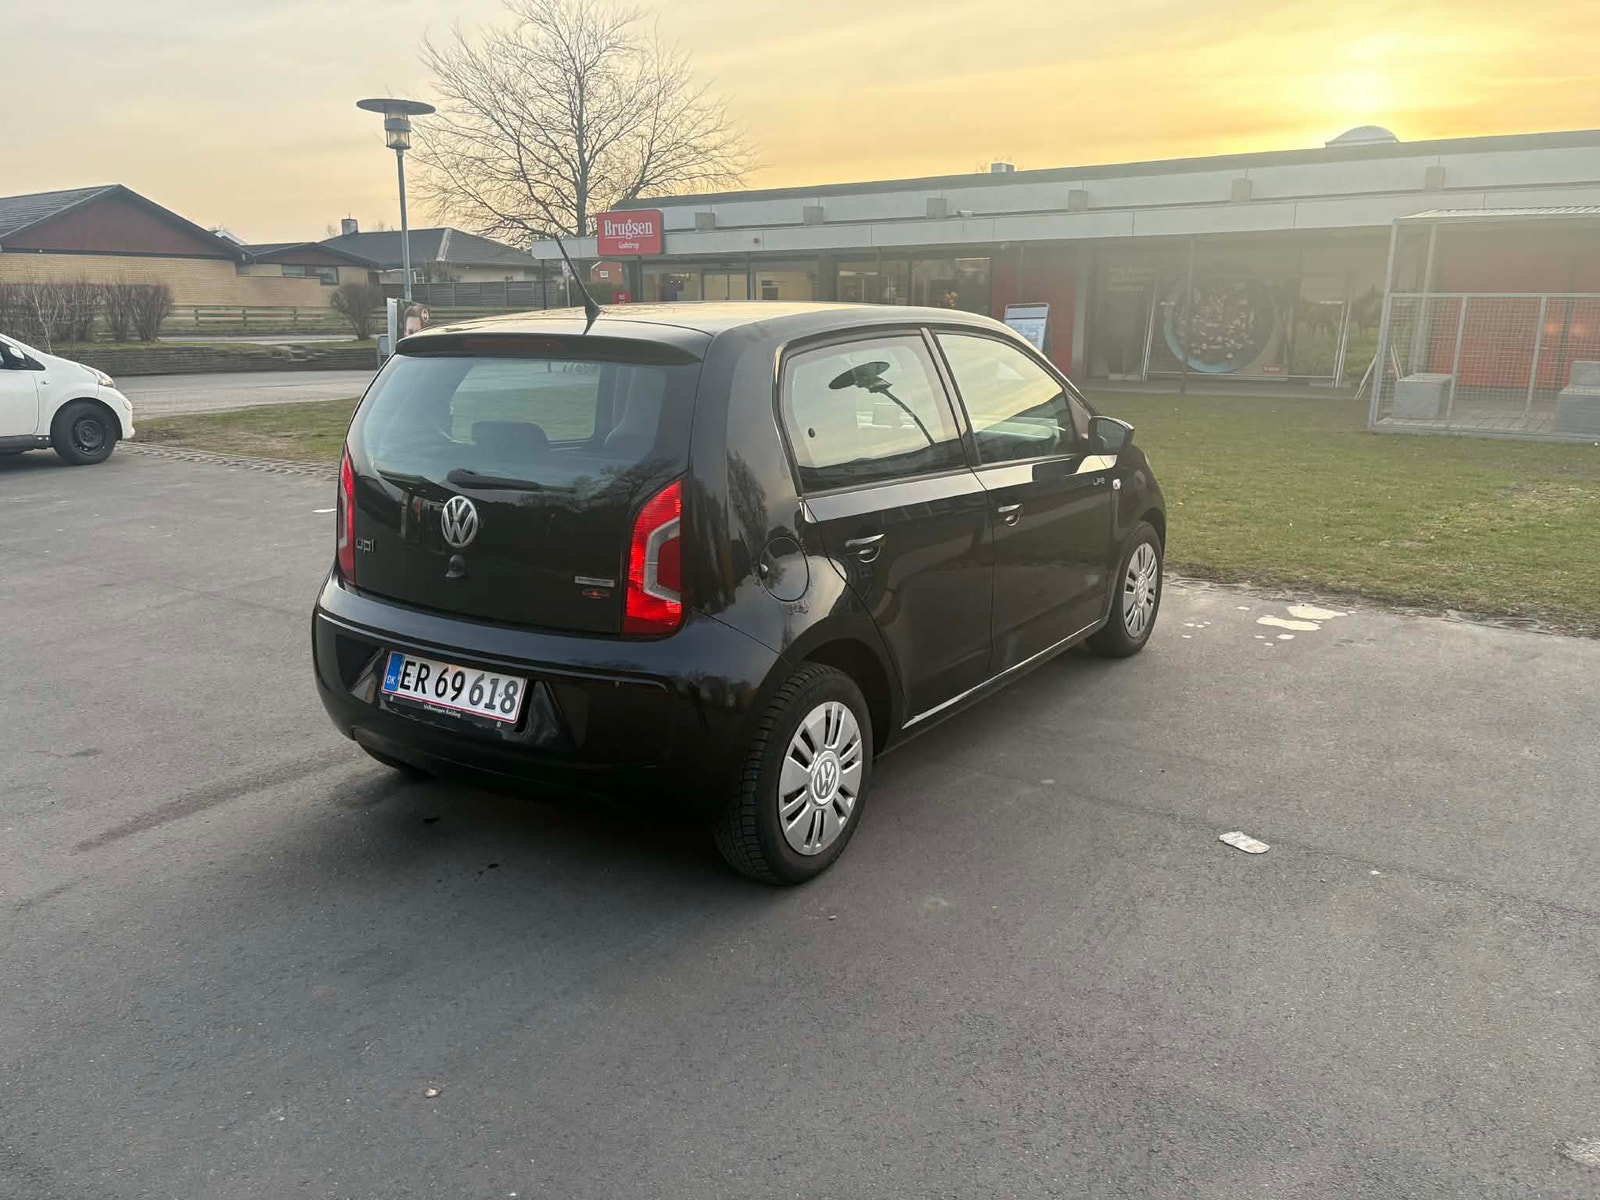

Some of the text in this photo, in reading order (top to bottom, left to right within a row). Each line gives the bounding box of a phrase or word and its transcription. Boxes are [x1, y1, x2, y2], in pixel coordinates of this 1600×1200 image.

[604, 219, 653, 239] Brugsen
[387, 675, 396, 685] DK
[400, 660, 519, 714] ER 69 618
